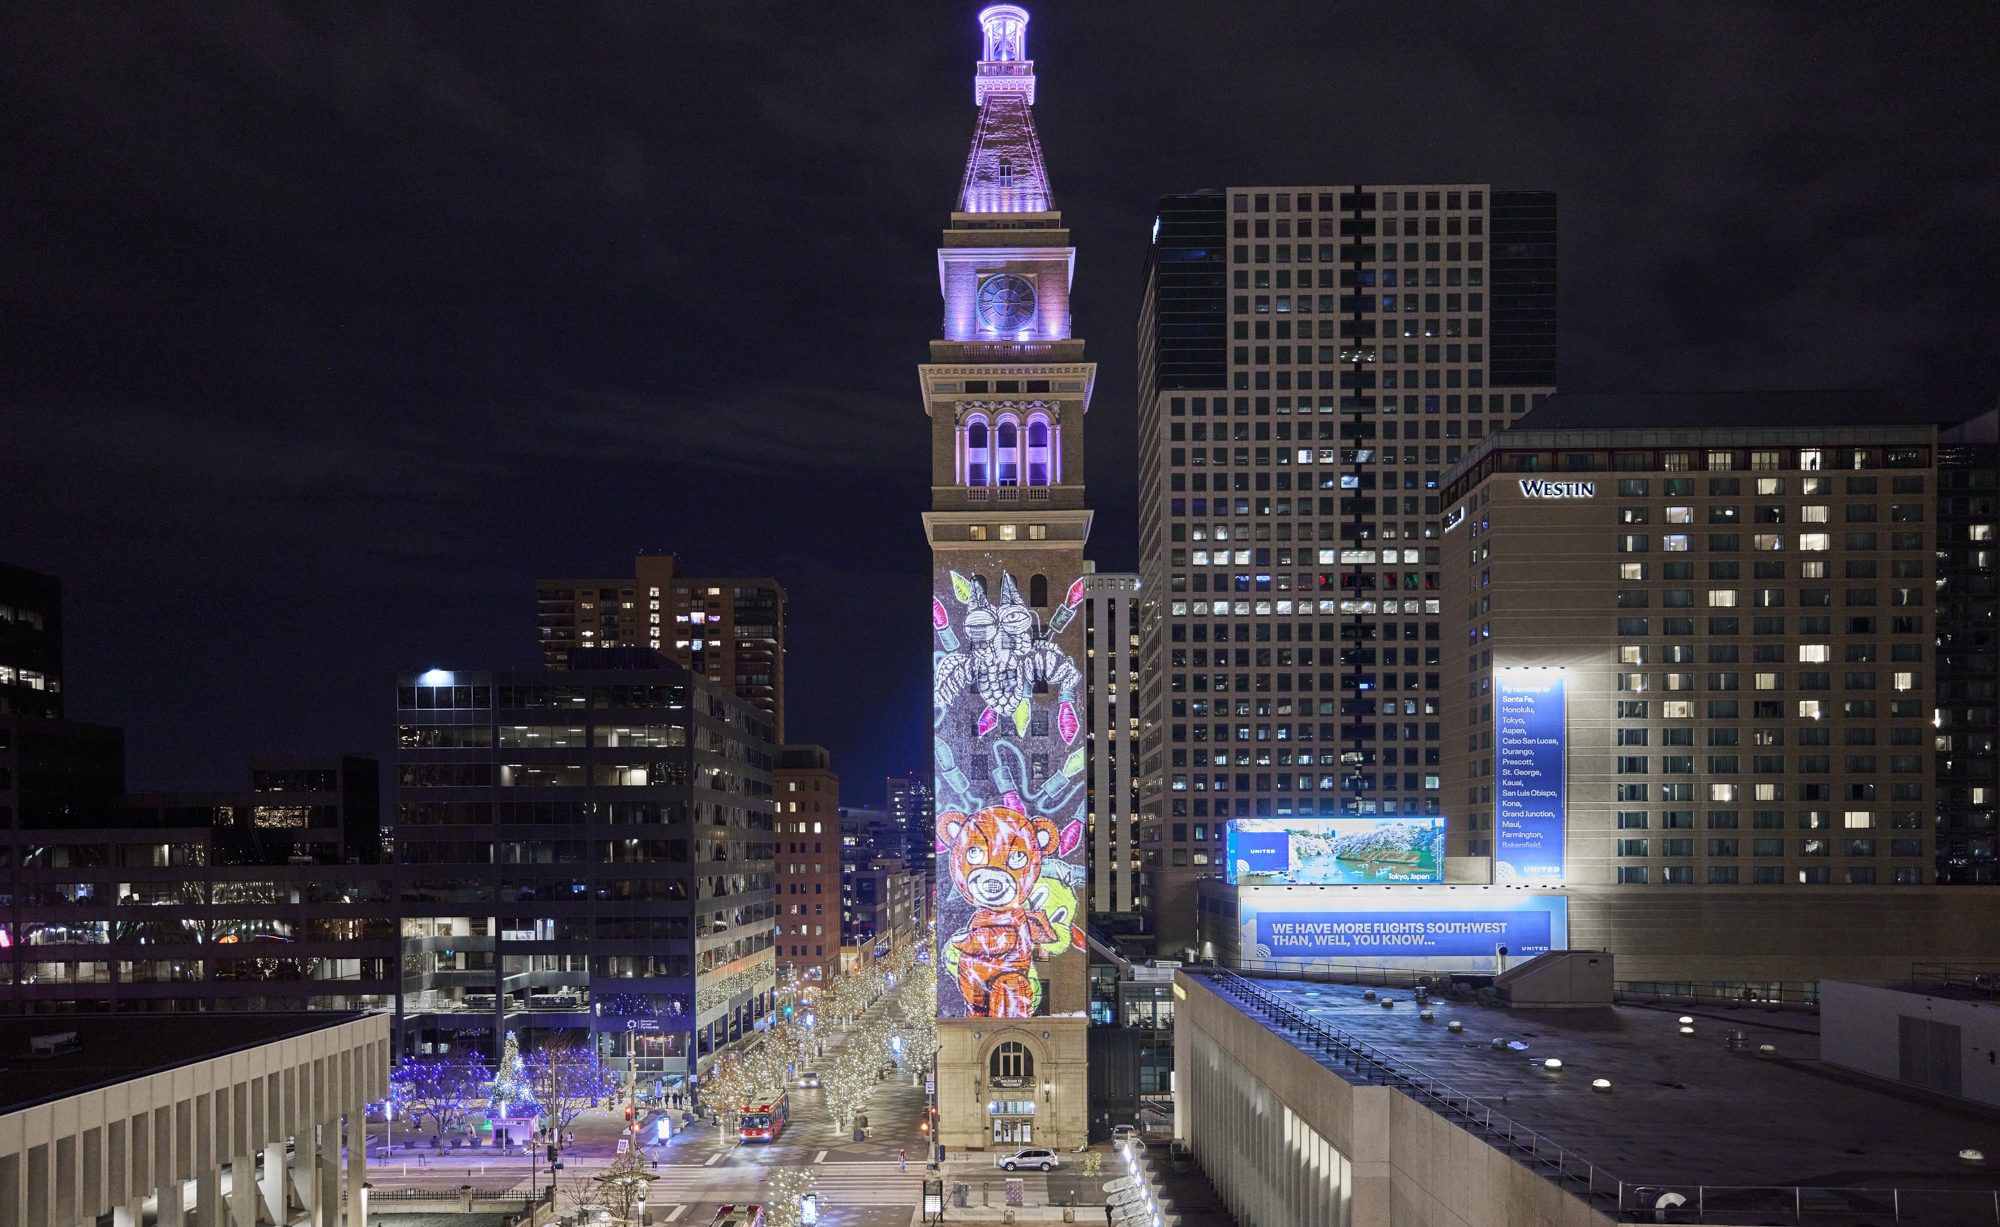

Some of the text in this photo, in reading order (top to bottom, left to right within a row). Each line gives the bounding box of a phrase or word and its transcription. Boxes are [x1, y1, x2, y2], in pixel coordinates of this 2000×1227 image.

[1519, 479, 1595, 498] WESTIN
[1502, 685, 1513, 694] Fly
[1513, 686, 1542, 694] nonstop
[1524, 696, 1534, 704] Fe,
[1502, 706, 1535, 714] Honolulu,
[1502, 716, 1525, 725] Tokyo,
[1502, 727, 1527, 735] Aspen,
[1502, 737, 1559, 745] Cabo San Lucas,
[1502, 748, 1535, 756] Durango,
[1502, 758, 1534, 766] Prescott,
[1513, 769, 1542, 777] George,
[1502, 779, 1524, 787] Kauai,
[1502, 800, 1523, 808] Kona,
[1525, 810, 1555, 818] Junction,
[1502, 820, 1522, 829] Maui,
[1502, 831, 1543, 839] Farmington,
[1502, 842, 1542, 850] Bakersfield,
[1388, 873, 1430, 881] Tokyo, Japan
[1272, 922, 1507, 934] WE HAVE MORE FLIGHTS SOUTHWEST
[1272, 934, 1435, 947] THAN, WELL, YOU KNOW...
